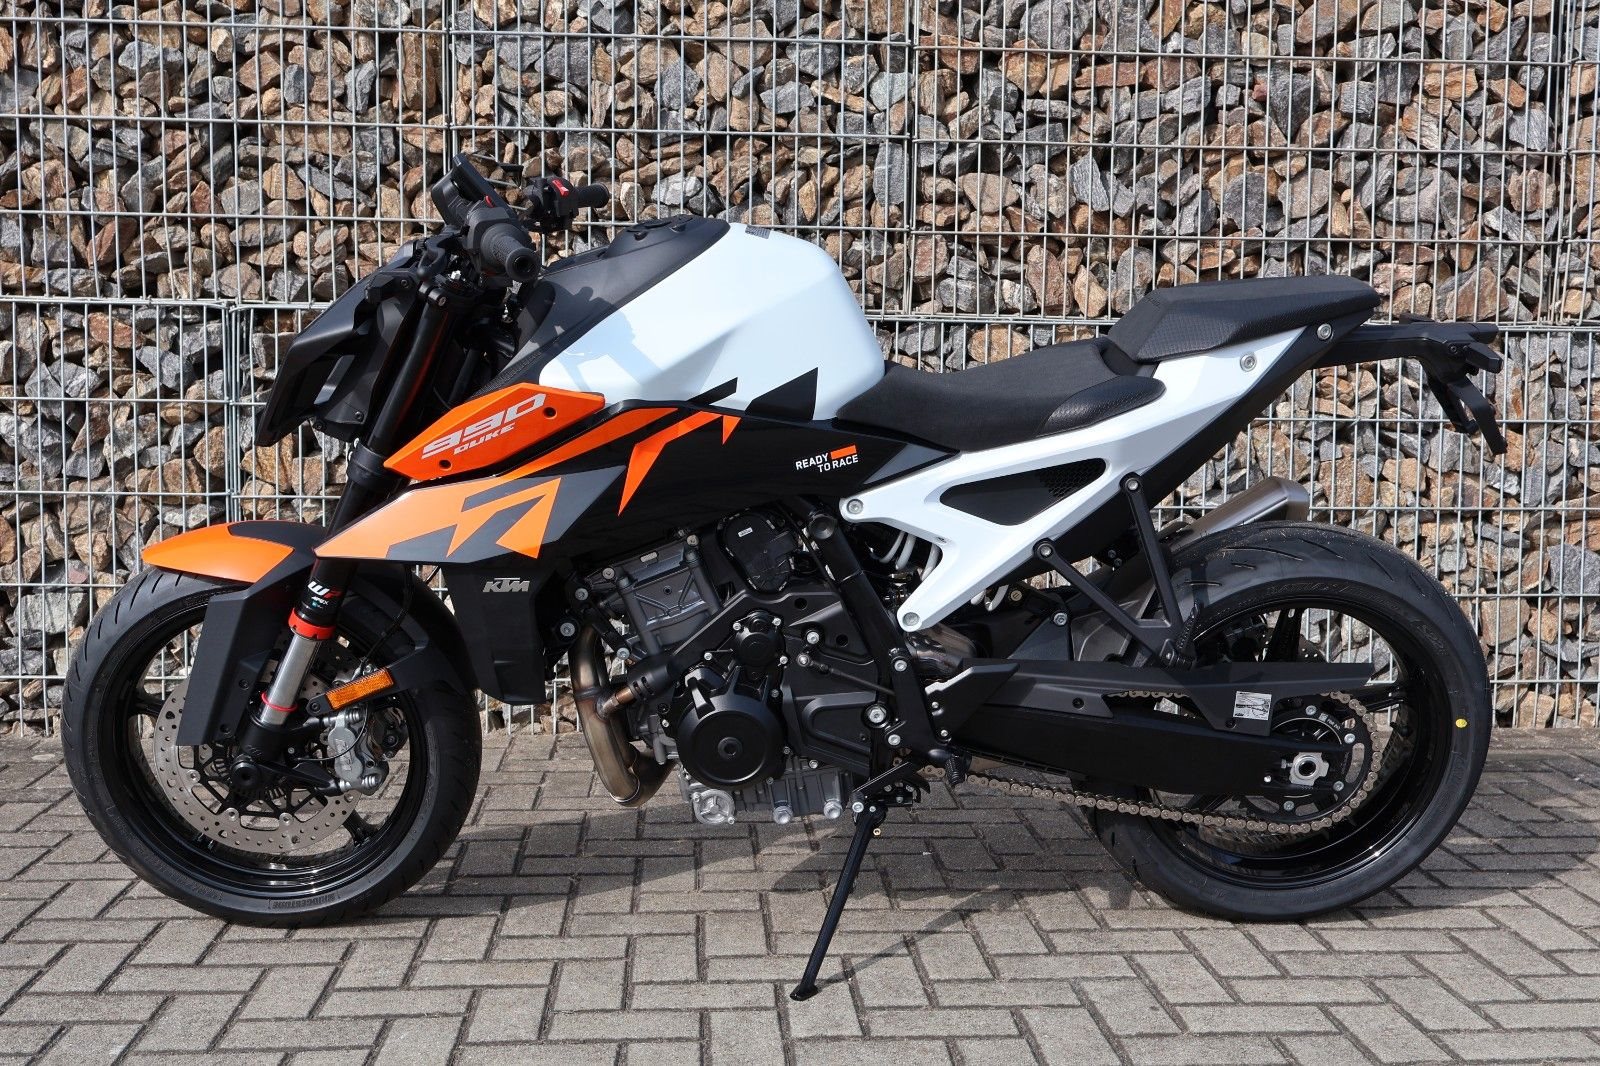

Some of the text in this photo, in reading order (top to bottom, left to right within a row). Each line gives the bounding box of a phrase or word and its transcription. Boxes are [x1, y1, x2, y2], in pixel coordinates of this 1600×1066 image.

[421, 393, 547, 459] 990
[453, 423, 516, 455] DUKE
[795, 452, 829, 470] READY
[817, 454, 859, 473] TO RACE
[482, 577, 530, 592] KTM
